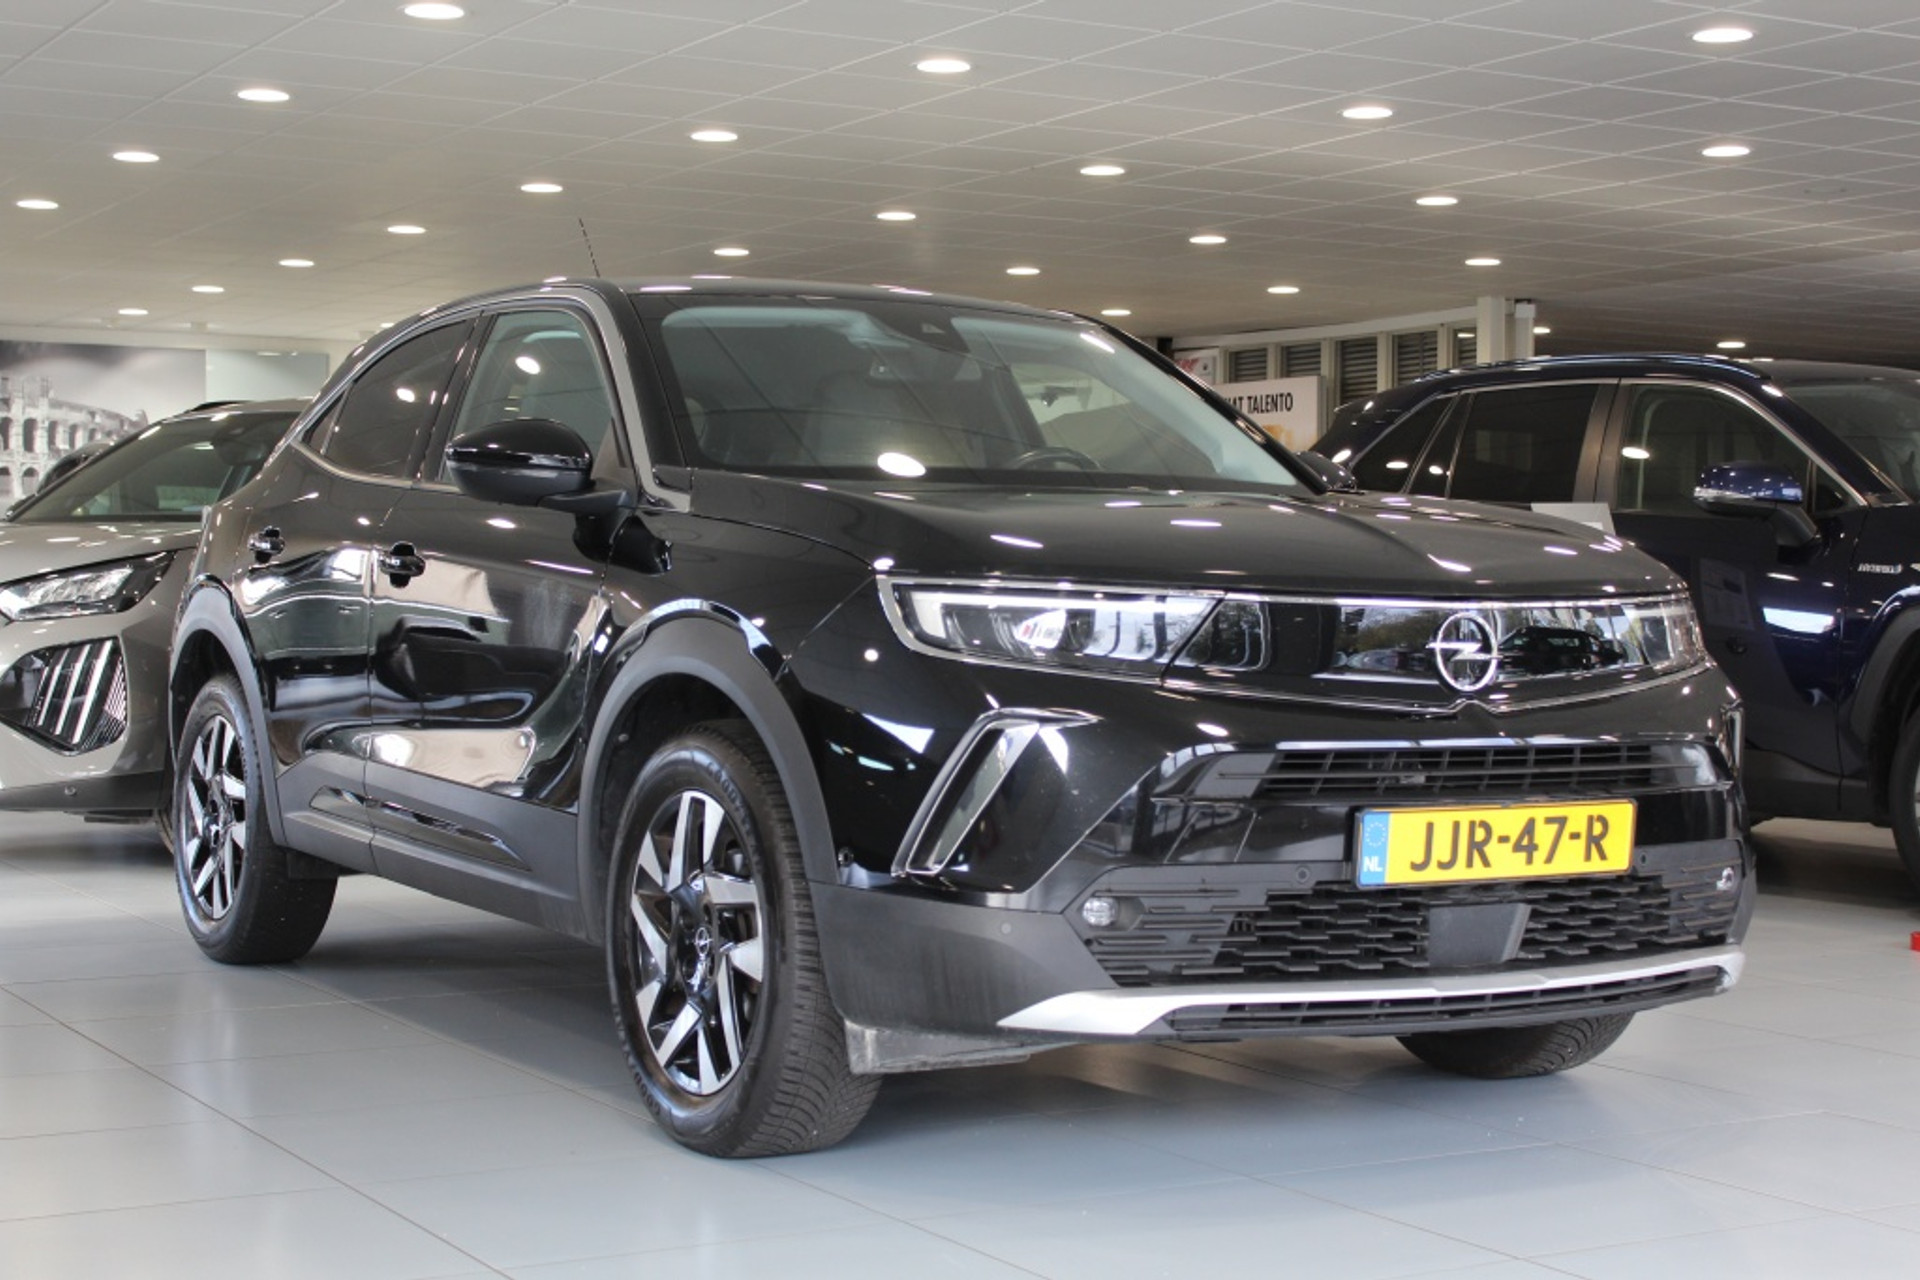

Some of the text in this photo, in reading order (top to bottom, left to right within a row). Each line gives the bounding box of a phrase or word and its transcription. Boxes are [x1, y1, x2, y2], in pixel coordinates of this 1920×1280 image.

[1247, 392, 1294, 414] TALENTO
[1410, 814, 1610, 872] JJR-47-R
[1363, 855, 1383, 873] NL
